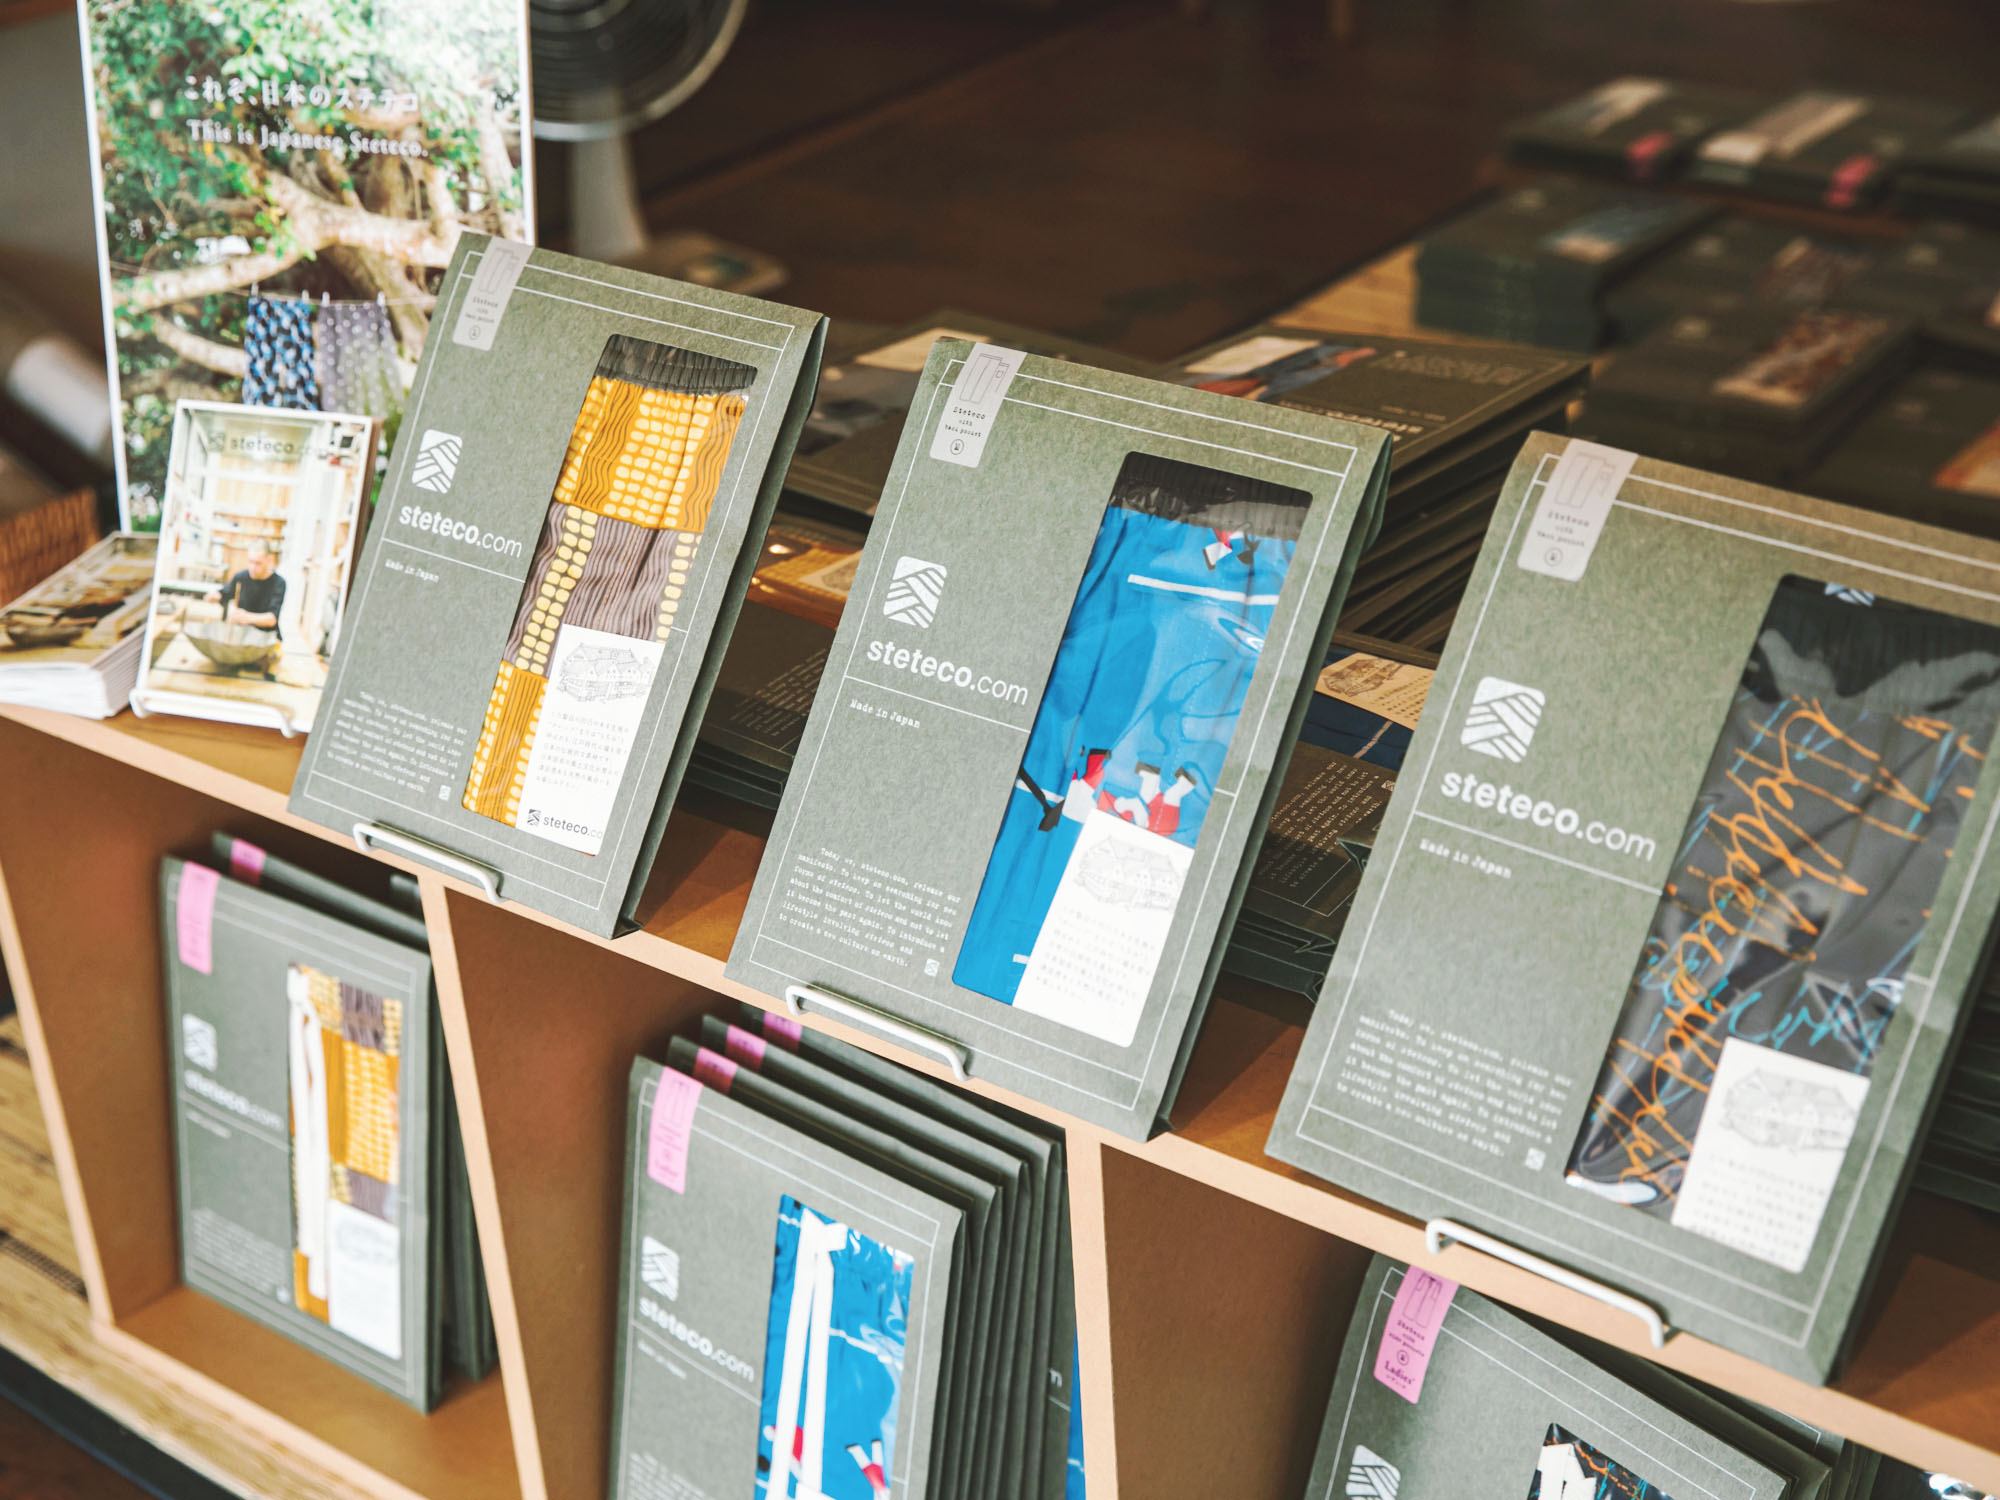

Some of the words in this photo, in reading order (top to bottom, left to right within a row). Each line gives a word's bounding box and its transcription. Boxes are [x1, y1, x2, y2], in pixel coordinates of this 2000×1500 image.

[186, 118, 232, 144] This
[237, 122, 254, 144] is
[259, 124, 344, 153] Japanese
[399, 505, 522, 558] steteco.com
[867, 640, 1028, 705] steteco.com
[850, 698, 873, 714] Made
[875, 708, 887, 719] in
[889, 711, 921, 729] Japan
[1441, 772, 1656, 861] steteco.com
[1419, 838, 1450, 858] Made
[1453, 851, 1469, 865] in
[1471, 854, 1512, 879] Japan
